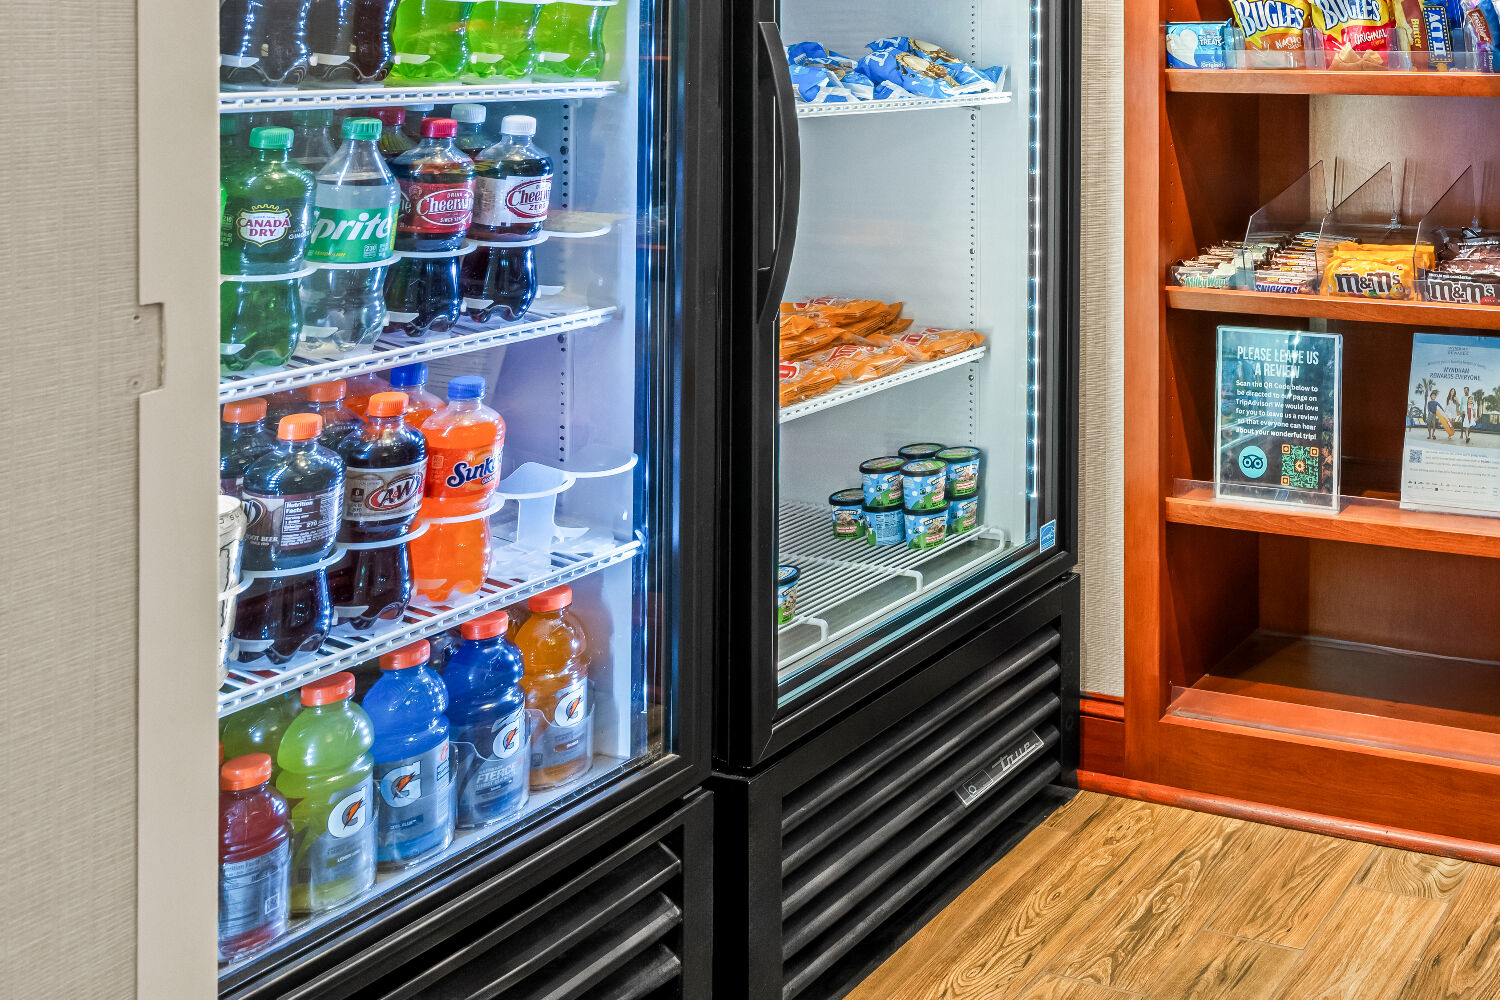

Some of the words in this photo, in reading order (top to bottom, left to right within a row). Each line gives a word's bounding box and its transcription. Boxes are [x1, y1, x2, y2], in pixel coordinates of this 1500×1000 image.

[1354, 29, 1387, 45] ORIGINAL
[1411, 18, 1421, 48] Butter
[1275, 37, 1302, 49] NACHO
[236, 218, 291, 228] CANADA
[249, 228, 276, 236] DRY
[1185, 276, 1207, 288] Milky
[1207, 276, 1226, 287] Way
[1237, 346, 1271, 361] PLEASE
[1275, 349, 1304, 364] LEAVE
[1307, 351, 1319, 365] US
[1255, 363, 1261, 376] A
[1264, 363, 1300, 378] REVIEW
[1292, 384, 1310, 392] below
[1292, 394, 1307, 402] page
[1271, 430, 1302, 438] wonderful
[286, 500, 314, 508] Nutrition
